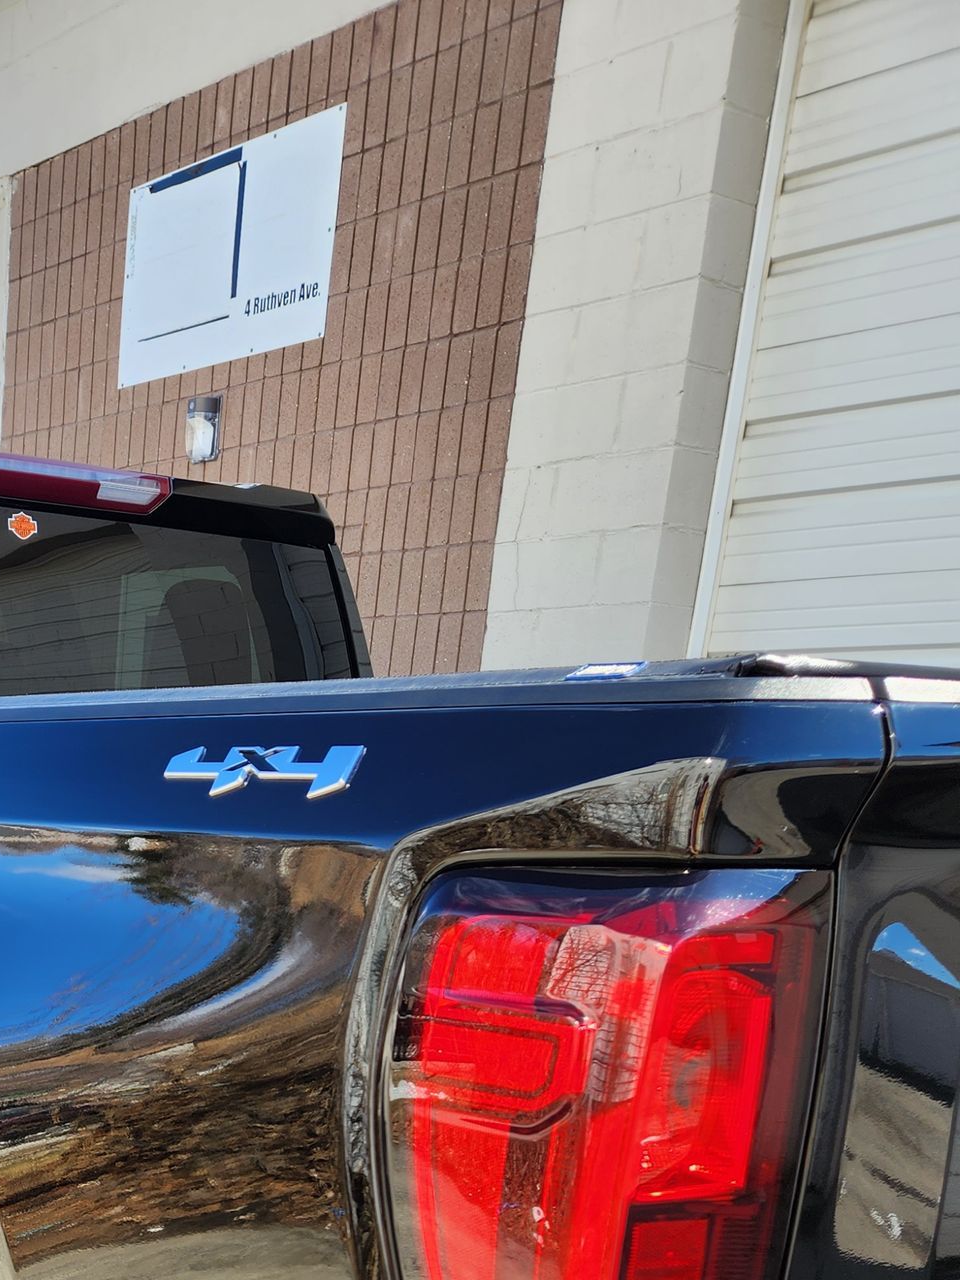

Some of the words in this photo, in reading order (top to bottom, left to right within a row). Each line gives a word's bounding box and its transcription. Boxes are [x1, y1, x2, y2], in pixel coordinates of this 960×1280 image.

[244, 298, 251, 317] 4
[253, 288, 296, 315] Ruthven
[298, 282, 321, 302] Ave.
